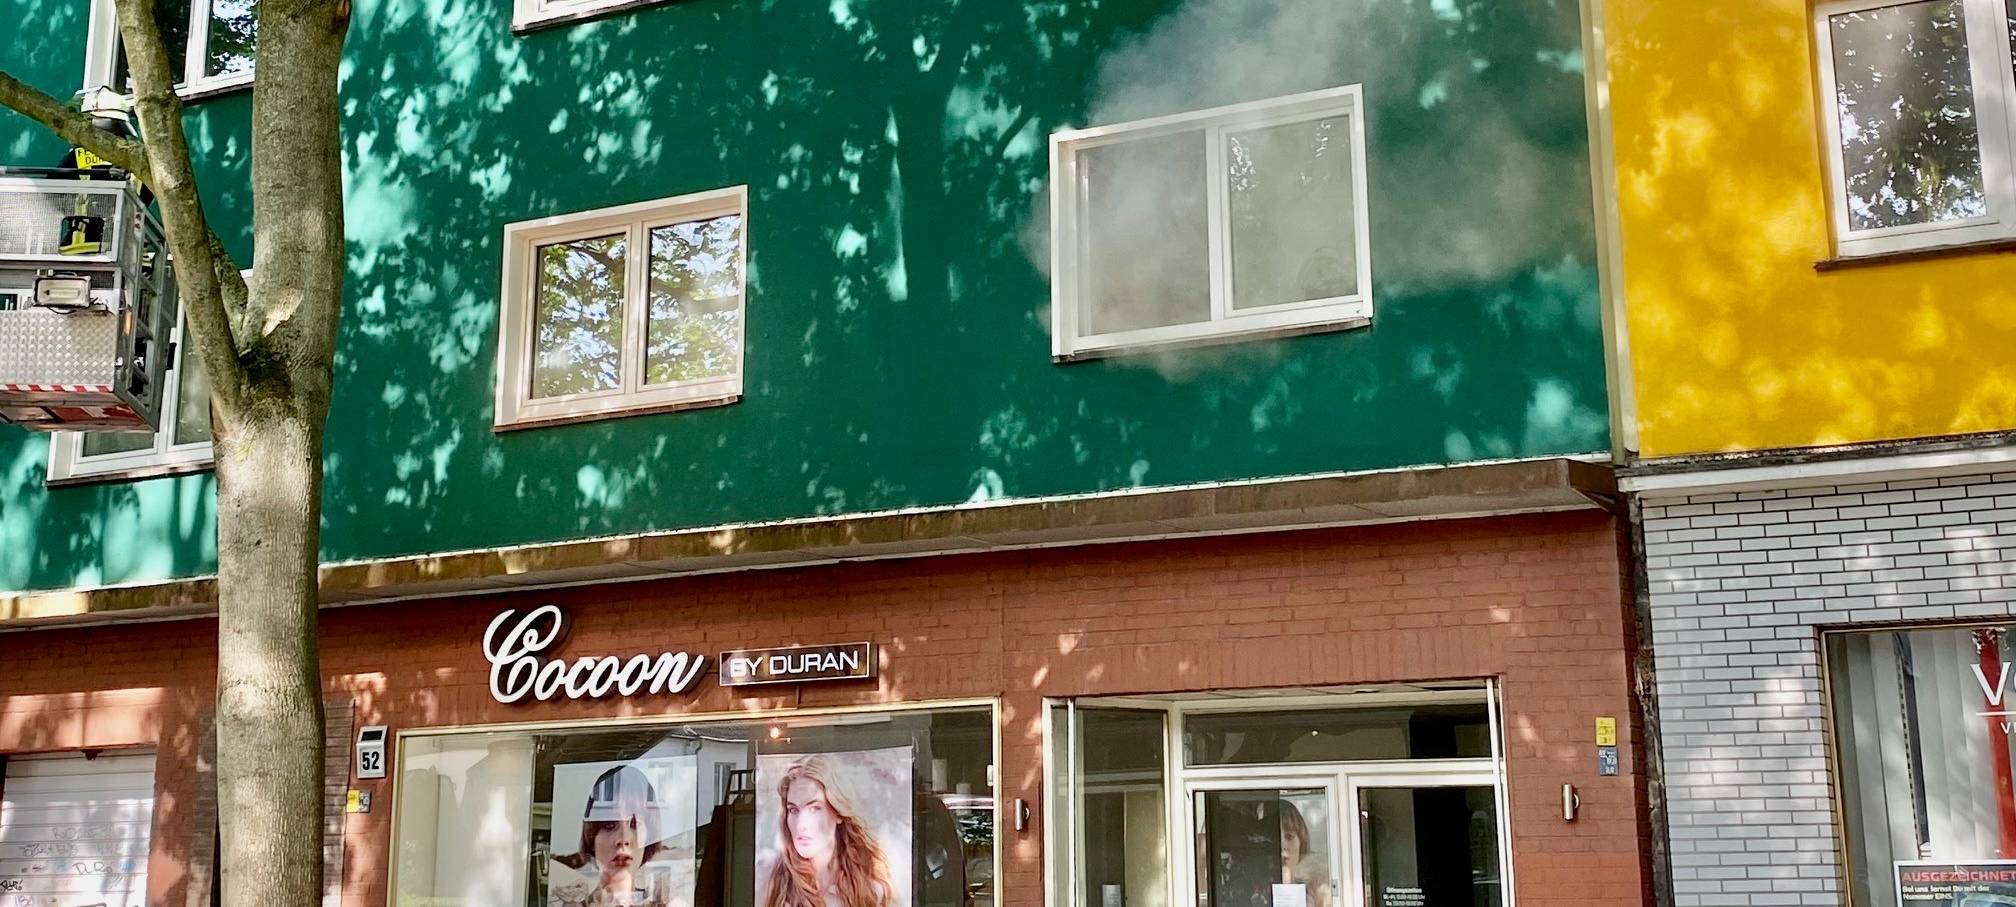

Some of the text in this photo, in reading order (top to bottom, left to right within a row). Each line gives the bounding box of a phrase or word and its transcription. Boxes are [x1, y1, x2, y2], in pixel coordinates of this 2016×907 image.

[483, 604, 704, 703] Cocoon
[730, 649, 859, 678] BY DURAN
[1969, 662, 2016, 706] V
[362, 751, 380, 770] 52
[1902, 871, 2016, 882] AUSGEZEICHNET
